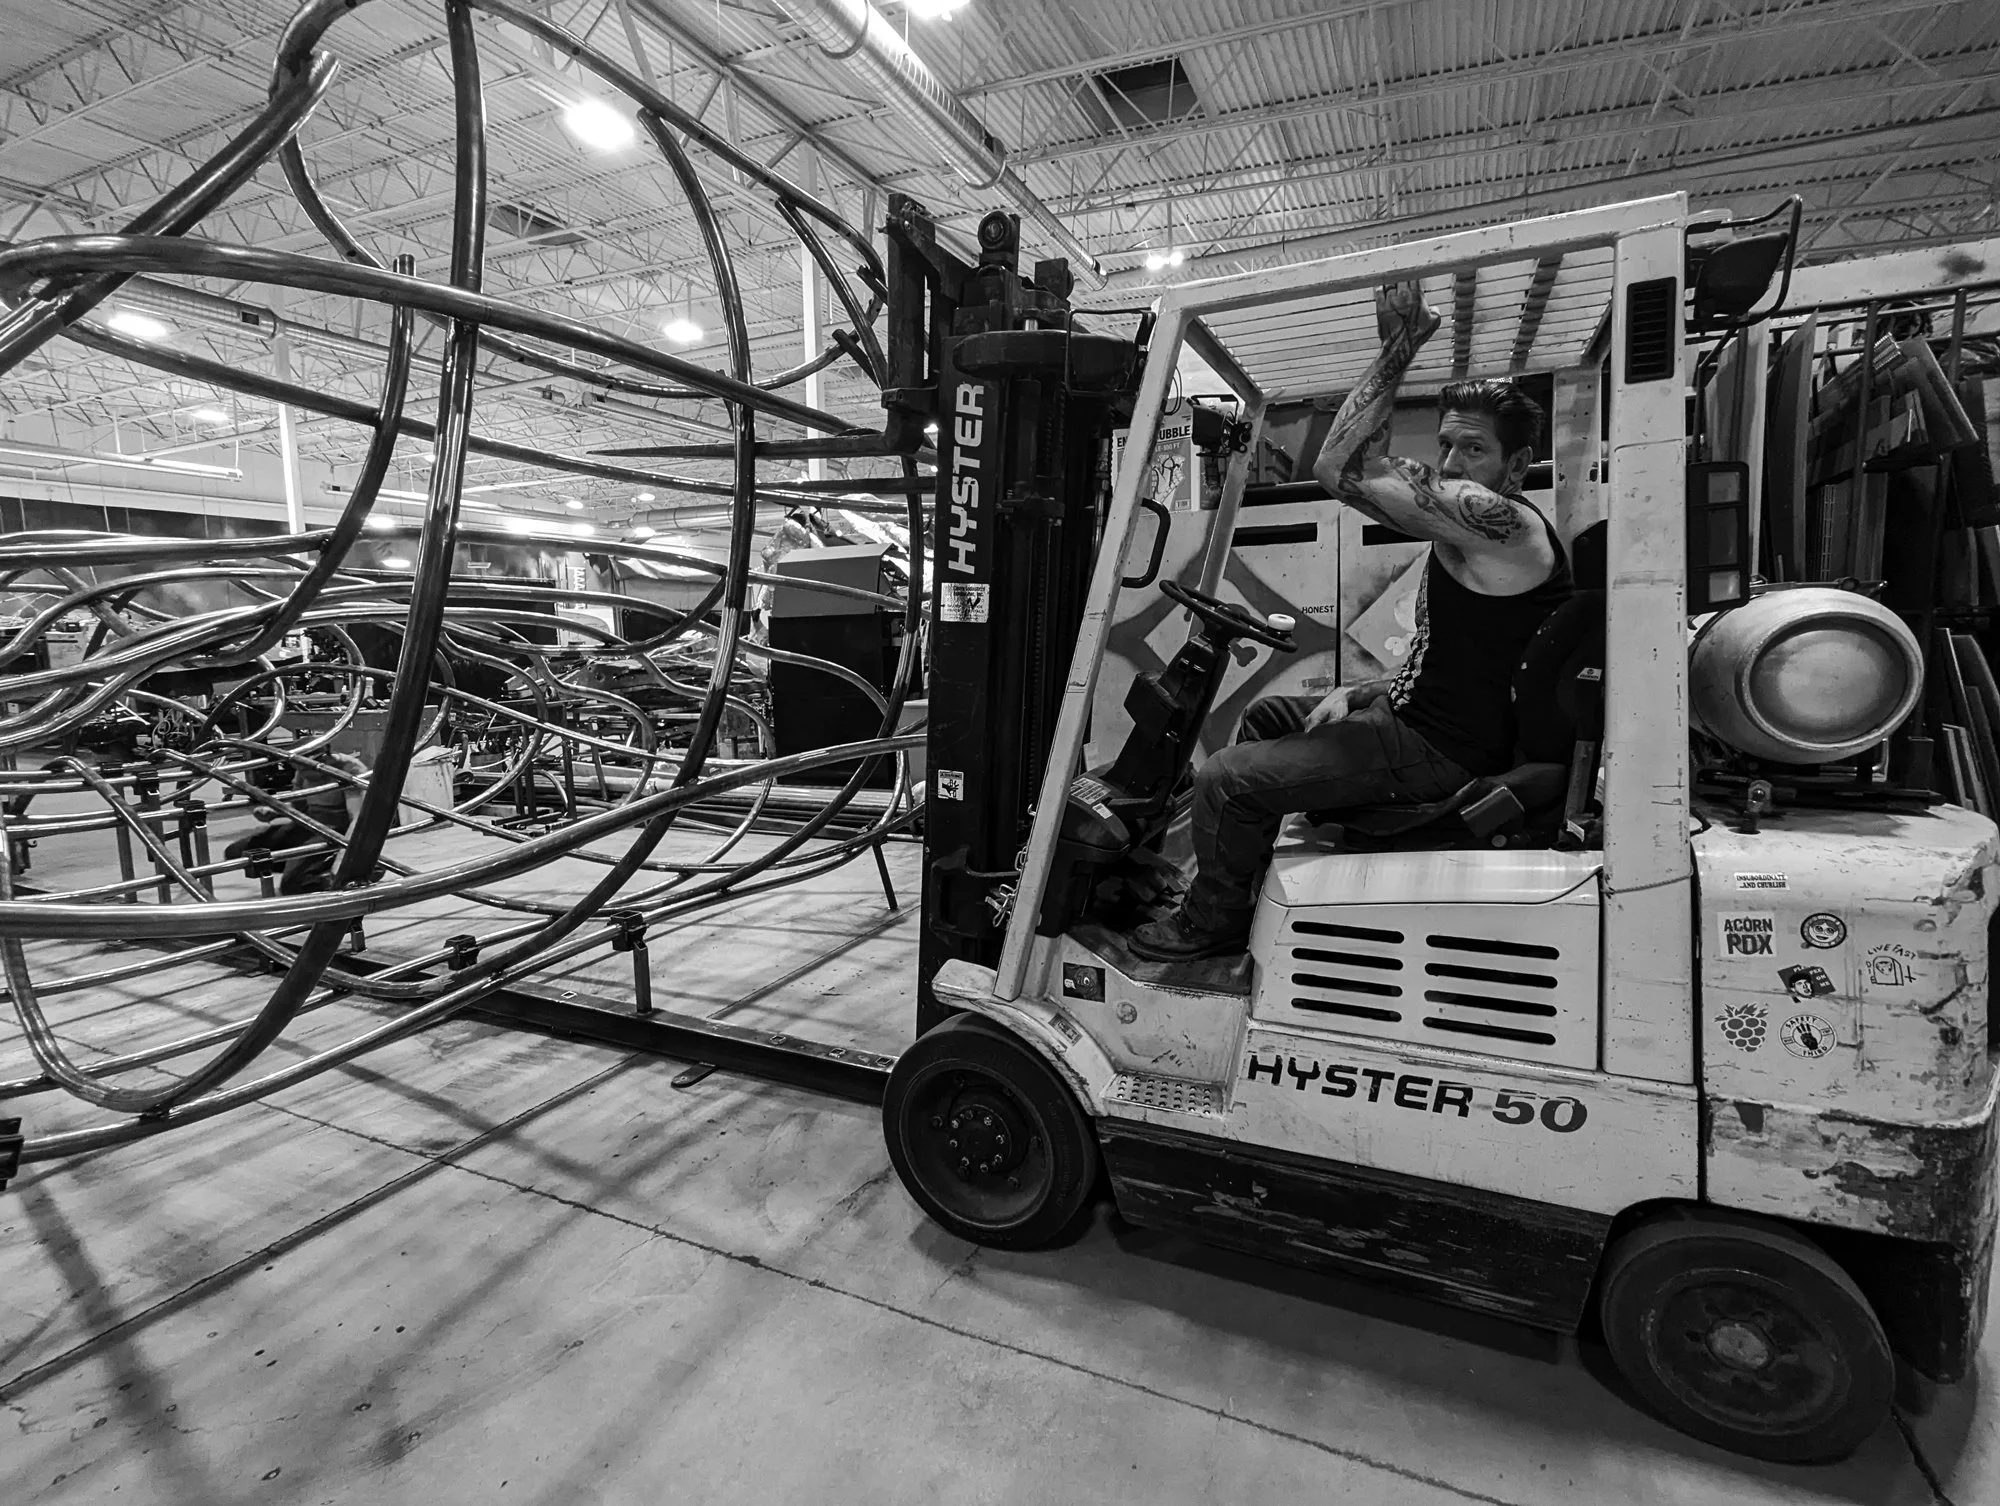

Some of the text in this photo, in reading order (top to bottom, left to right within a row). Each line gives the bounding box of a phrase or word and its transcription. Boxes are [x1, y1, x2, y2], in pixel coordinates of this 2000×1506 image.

[1159, 425, 1191, 440] UBBLE
[948, 383, 985, 575] HYSTER
[1301, 605, 1335, 614] HONEST
[1724, 916, 1774, 932] ACORN
[1867, 943, 1891, 955] LIVE
[1785, 1016, 1816, 1028] SAFETY
[1802, 1046, 1828, 1056] THIRD
[1247, 1054, 1588, 1133] HYSTER 50
